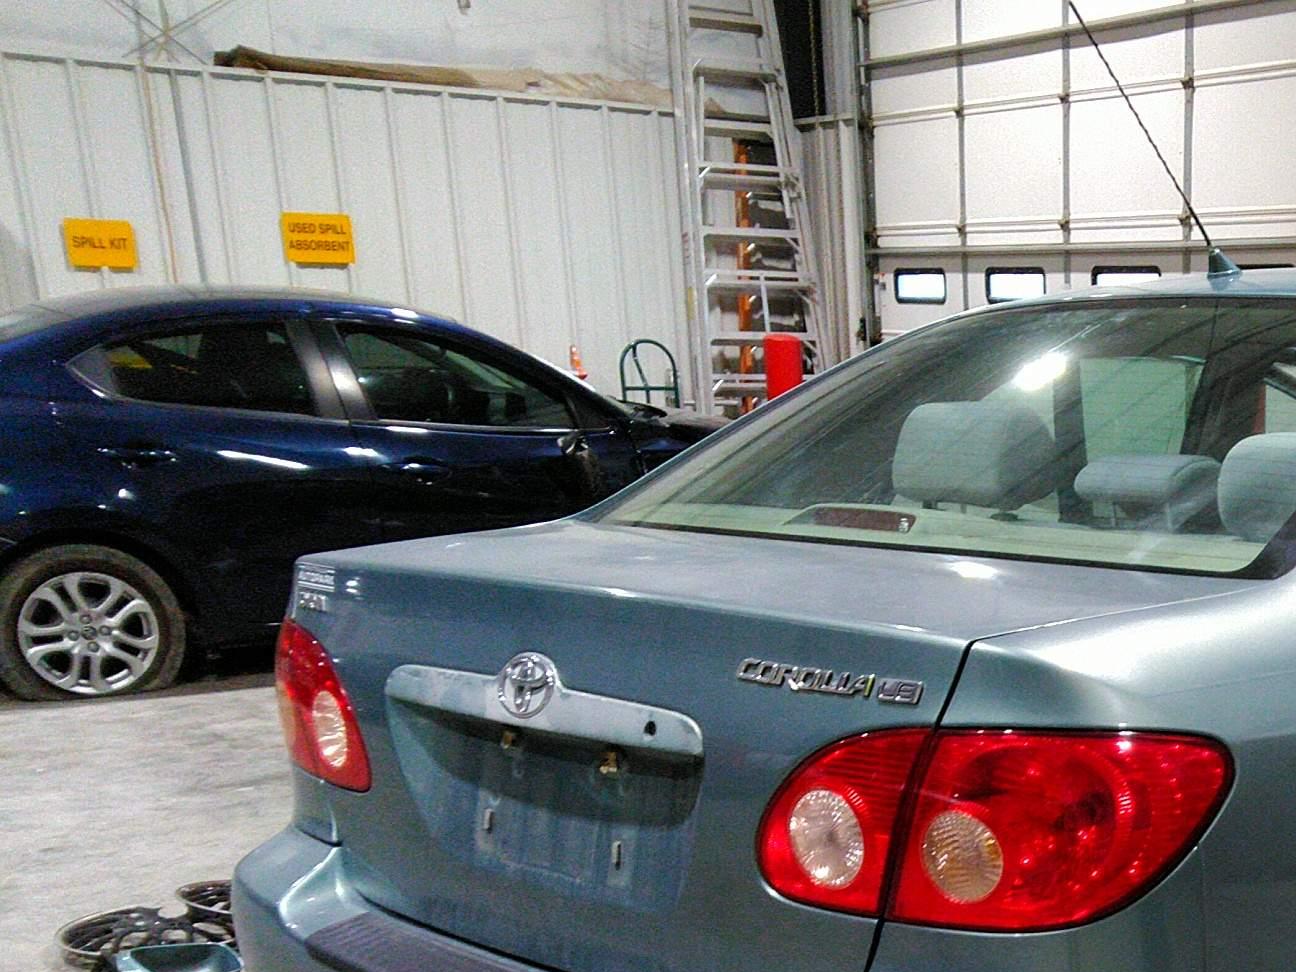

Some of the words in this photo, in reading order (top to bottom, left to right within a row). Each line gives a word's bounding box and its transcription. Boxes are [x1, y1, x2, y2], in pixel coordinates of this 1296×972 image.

[287, 222, 317, 234] USED
[318, 223, 347, 235] SPILL
[71, 235, 106, 249] SPILL
[109, 237, 128, 250] KIT
[287, 239, 351, 252] ABSORBENT
[736, 657, 876, 698] COROLLA
[877, 677, 926, 705] LE
